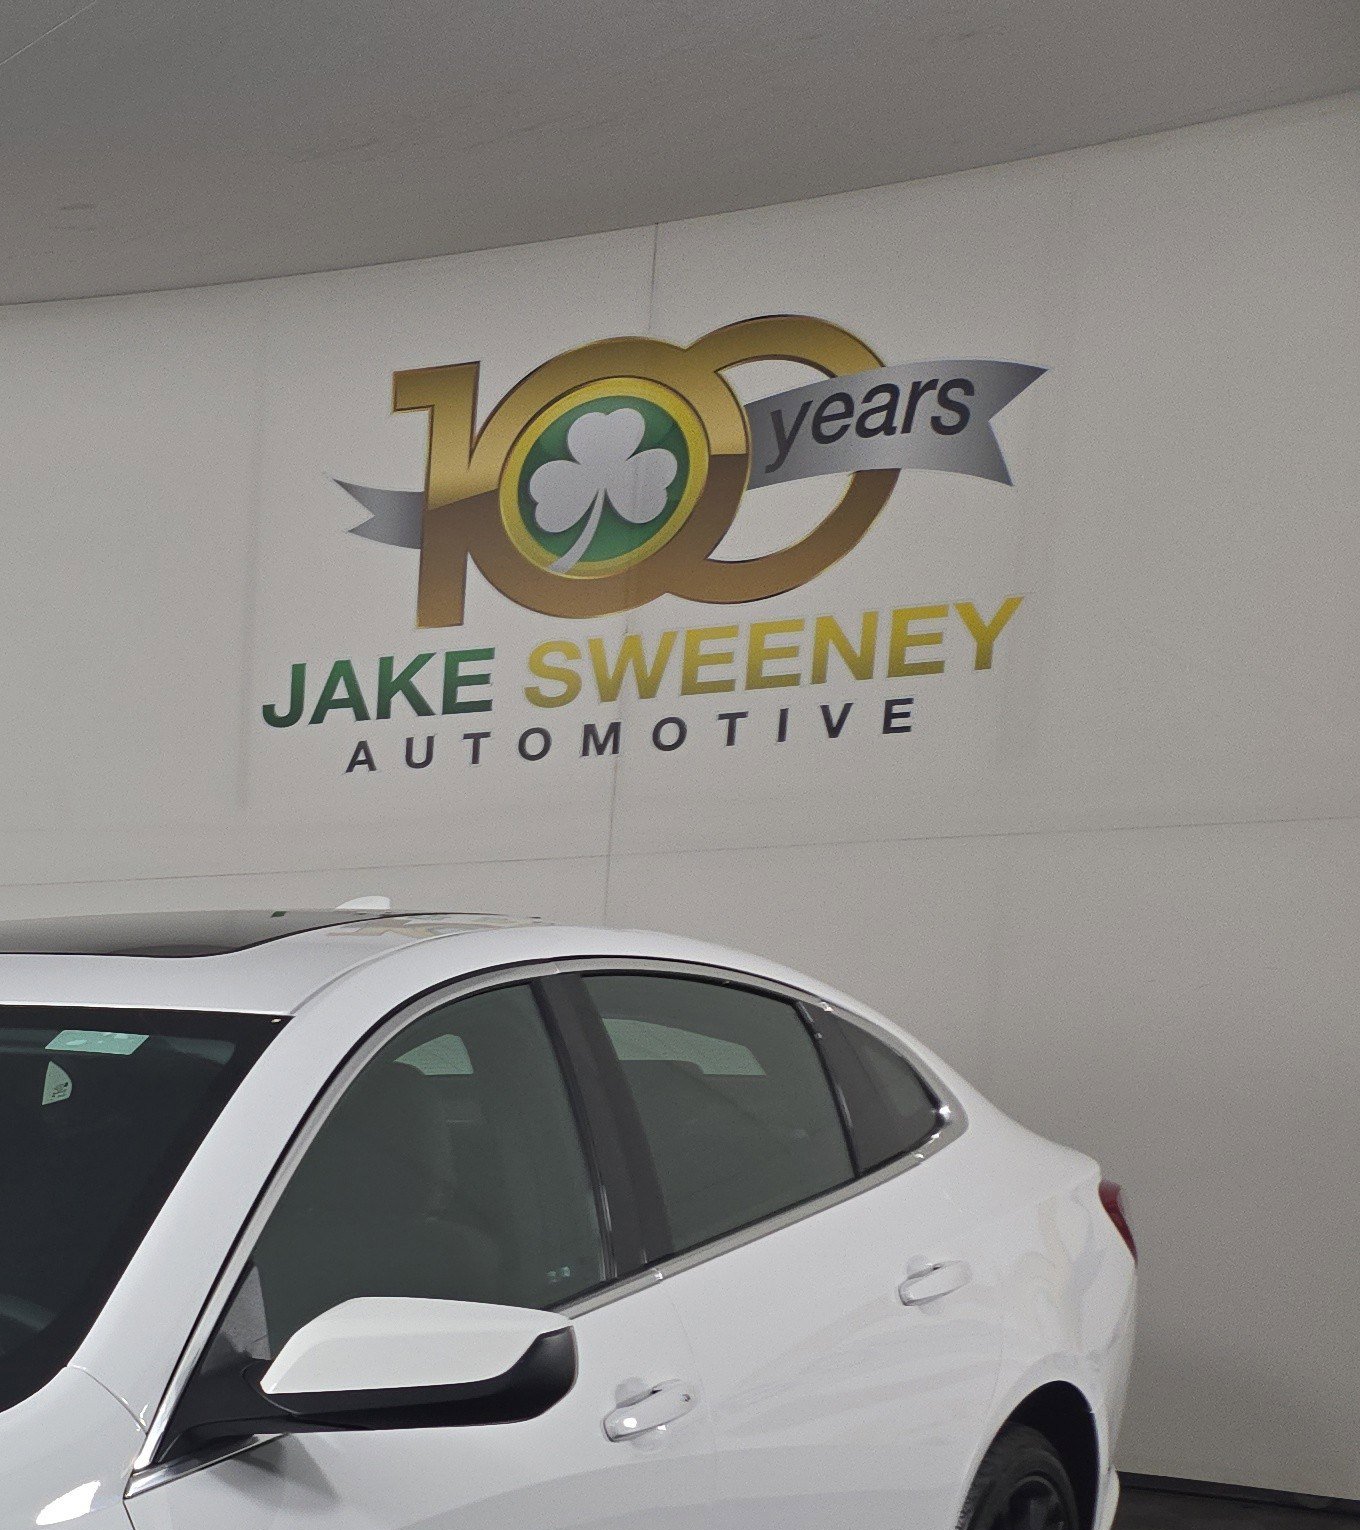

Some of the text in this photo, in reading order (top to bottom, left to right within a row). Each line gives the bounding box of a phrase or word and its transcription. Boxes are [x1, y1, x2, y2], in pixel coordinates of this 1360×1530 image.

[764, 373, 976, 474] years
[262, 597, 1025, 729] JAKE SWEENEY
[345, 698, 915, 775] AUTOMOTIVE
